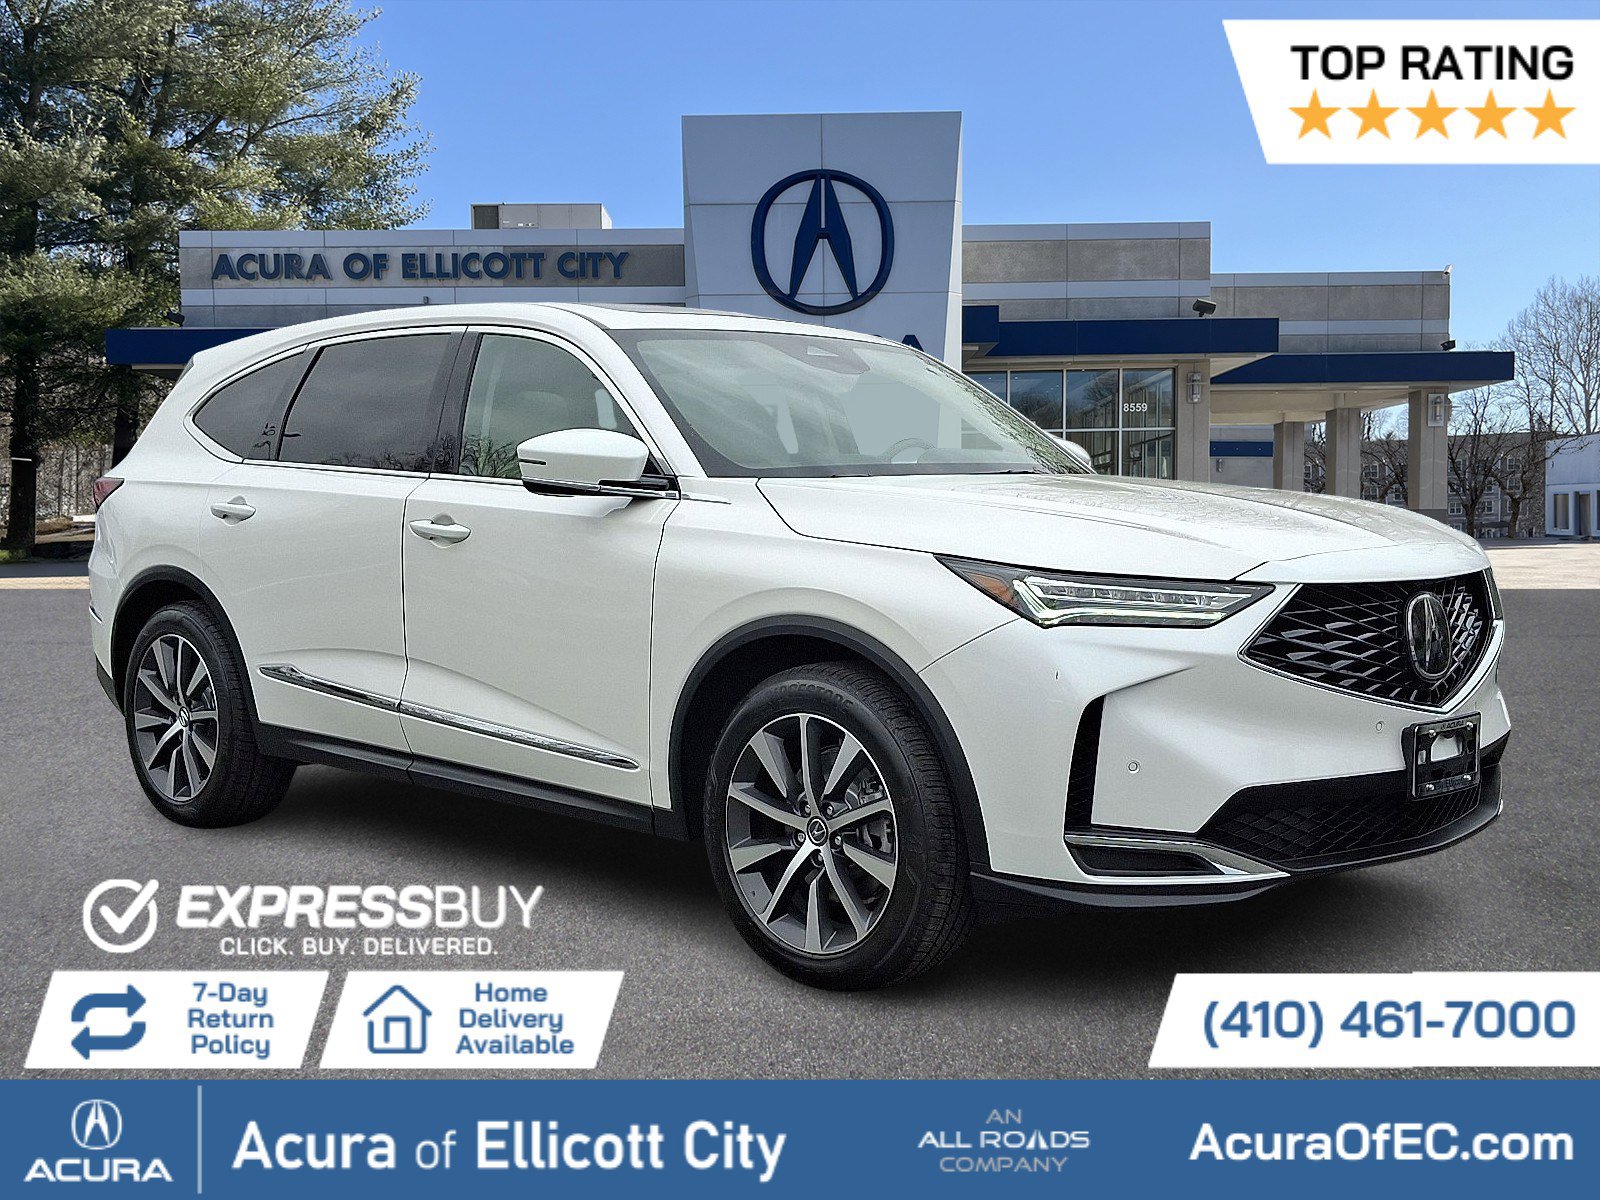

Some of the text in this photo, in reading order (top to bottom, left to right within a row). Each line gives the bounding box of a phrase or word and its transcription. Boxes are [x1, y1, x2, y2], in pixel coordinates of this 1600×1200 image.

[211, 251, 629, 281] ACURA OF ELLICOTT CITY
[1123, 403, 1148, 412] 8559
